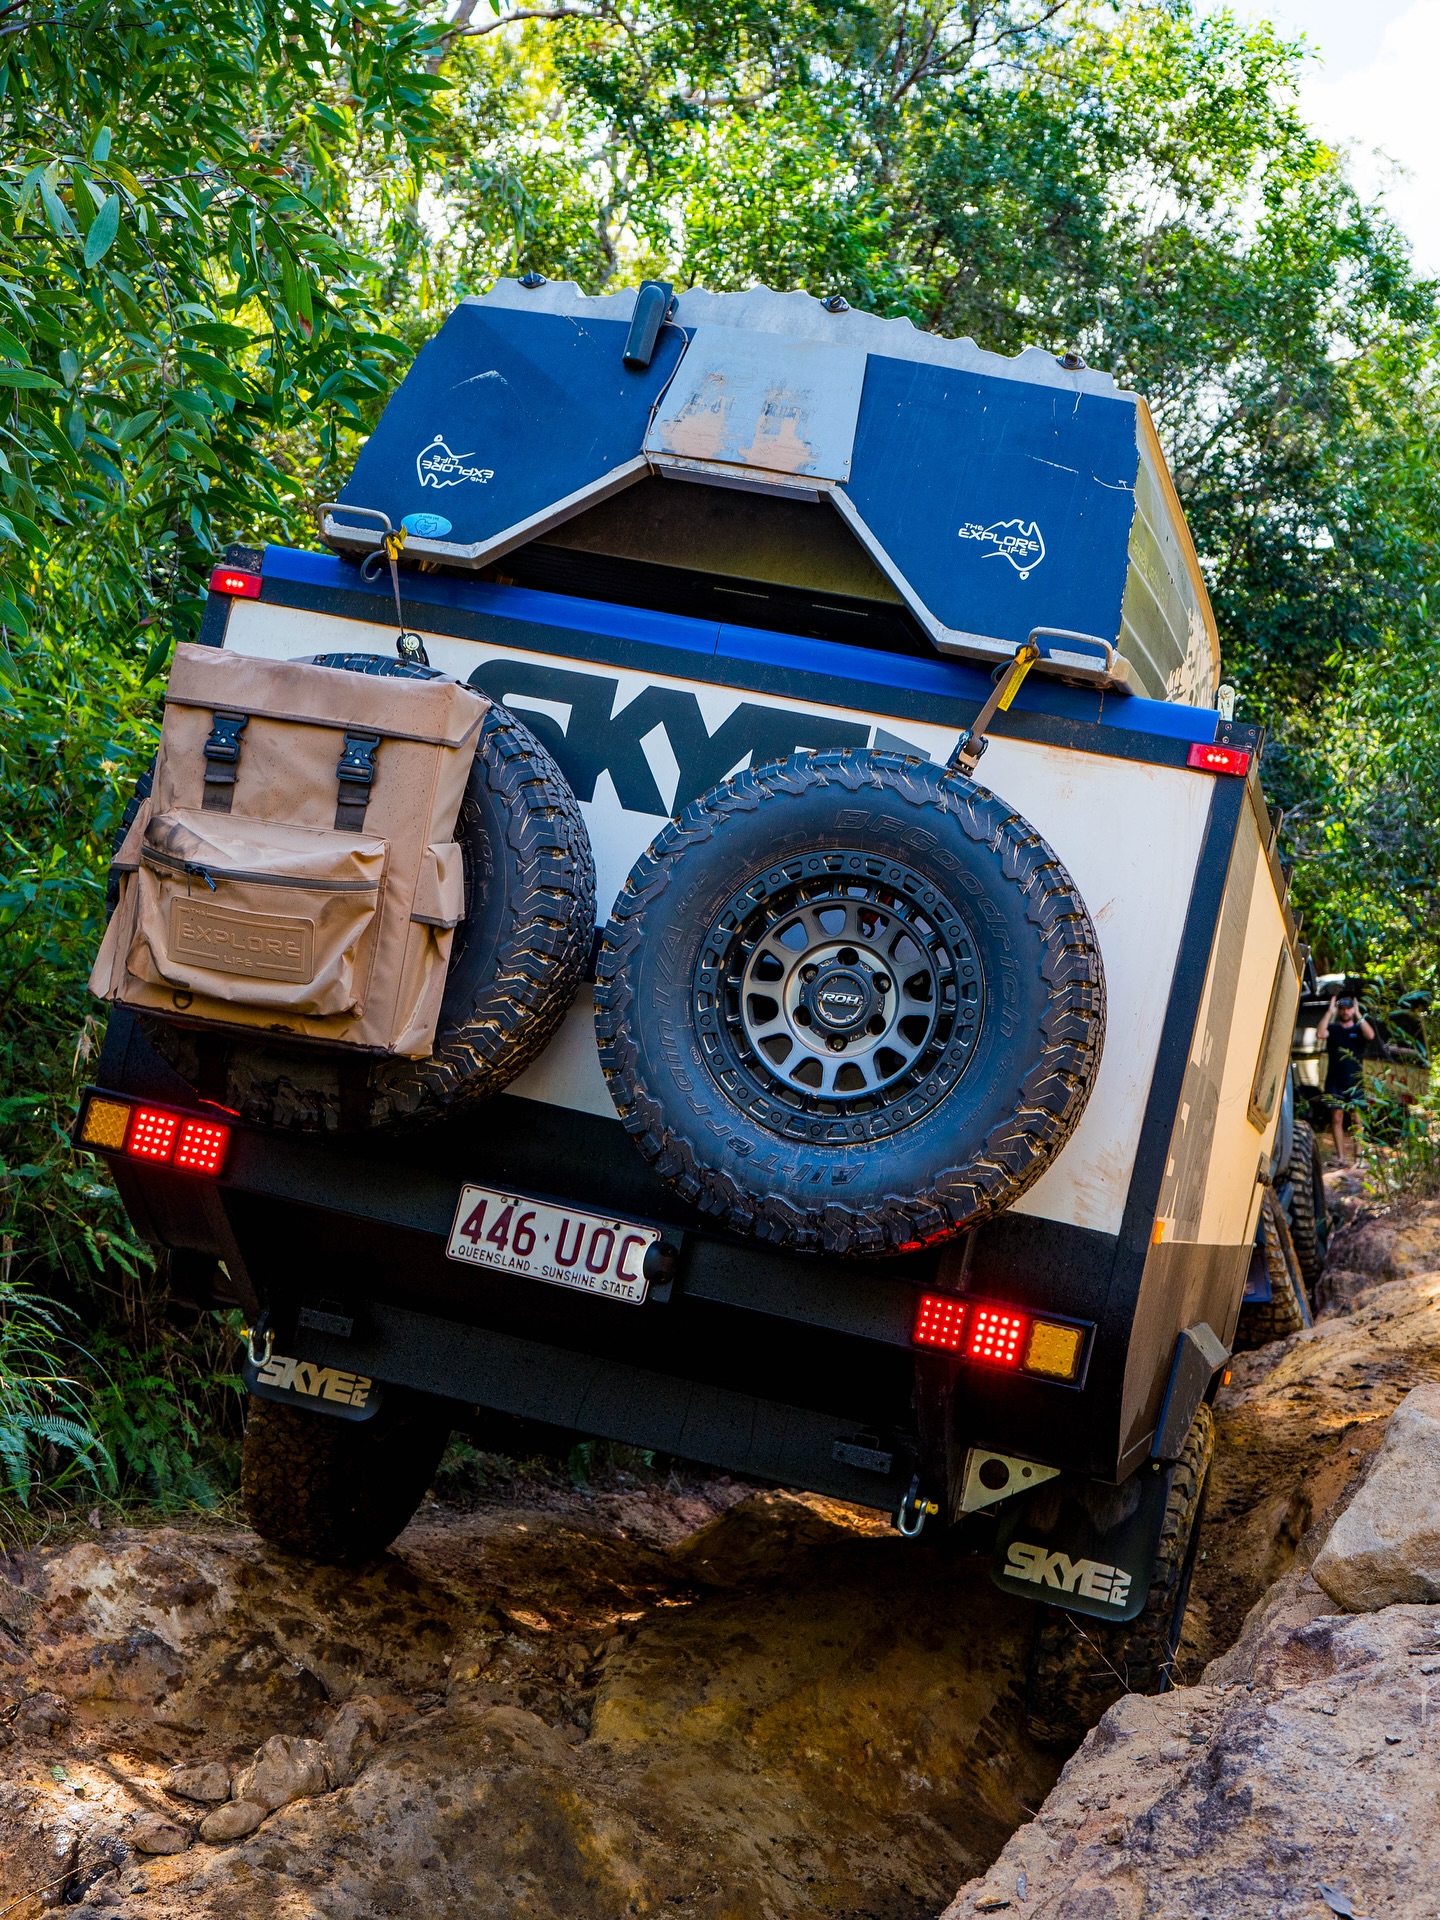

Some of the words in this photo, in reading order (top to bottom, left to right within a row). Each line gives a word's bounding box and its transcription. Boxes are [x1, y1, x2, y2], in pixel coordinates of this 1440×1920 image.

[421, 460, 494, 479] EXPLORE
[964, 522, 985, 532] THE
[958, 528, 1040, 552] EXPLORE
[998, 544, 1028, 557] LIFE
[180, 922, 300, 958] EXPLORE
[822, 992, 860, 1005] ROH
[458, 1245, 531, 1271] QUEENSLAND
[541, 1265, 597, 1288] SUNSHINE
[601, 1280, 635, 1297] STATE
[256, 1355, 357, 1405] SKYE
[349, 1375, 373, 1408] RV
[1003, 1541, 1116, 1602] SKYE
[1109, 1567, 1132, 1607] RV
